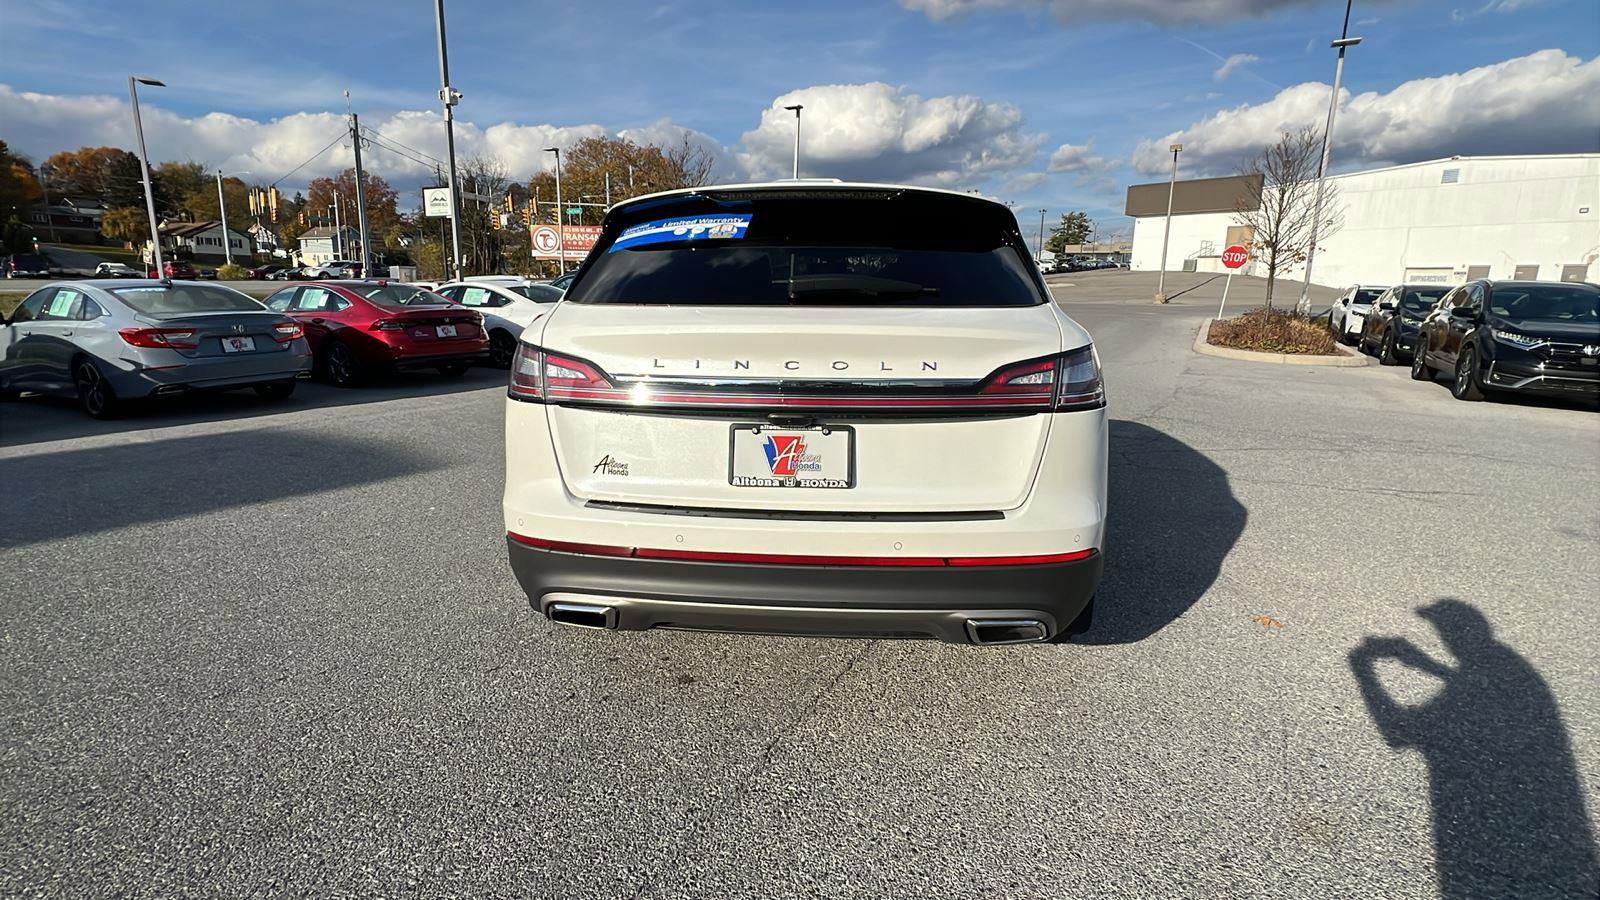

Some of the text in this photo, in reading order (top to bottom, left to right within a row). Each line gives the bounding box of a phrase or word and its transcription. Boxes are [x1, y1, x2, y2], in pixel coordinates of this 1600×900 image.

[662, 217, 744, 227] Limited Warranty
[1222, 252, 1247, 262] STOP
[653, 358, 938, 371] LINCOLN
[791, 462, 820, 471] Honda
[608, 468, 629, 476] Honda
[732, 477, 780, 487] Altoona
[799, 478, 848, 488] HONDA
